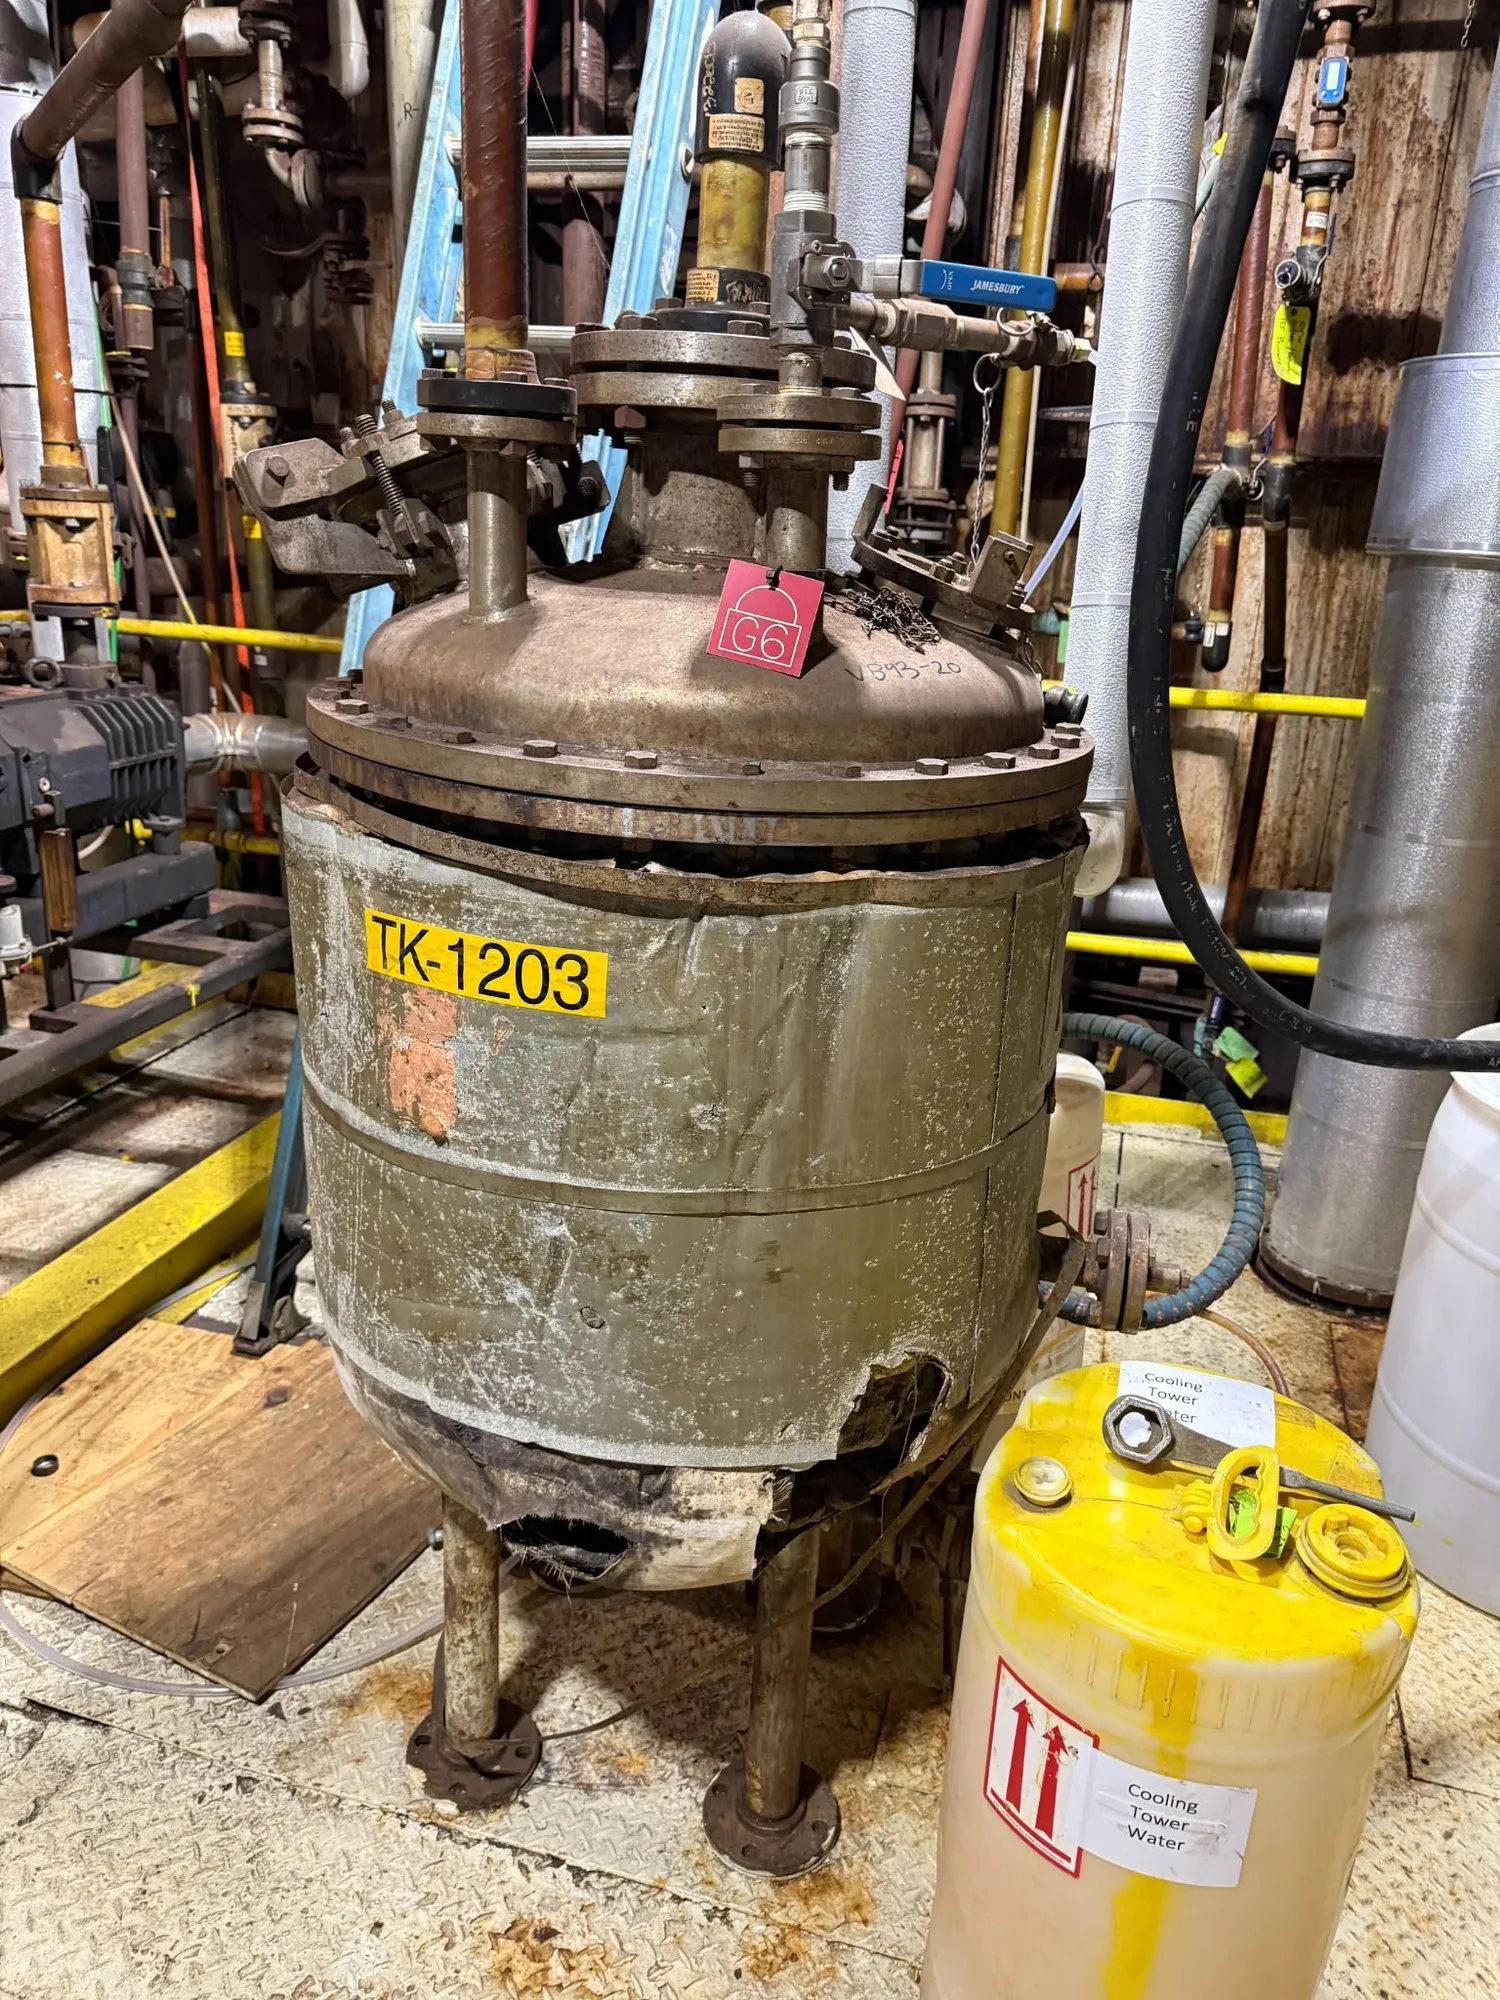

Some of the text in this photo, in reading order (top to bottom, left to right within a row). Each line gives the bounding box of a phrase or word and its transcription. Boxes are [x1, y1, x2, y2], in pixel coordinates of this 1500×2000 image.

[970, 280, 1022, 295] JAMESBURY
[732, 616, 789, 660] G6
[371, 915, 590, 1011] TK-1203
[1144, 1372, 1203, 1393] Cooling
[1147, 1386, 1199, 1406] Tower
[1128, 1783, 1199, 1815] Cooling
[1130, 1804, 1190, 1831] Tower
[1127, 1824, 1186, 1851] Water
